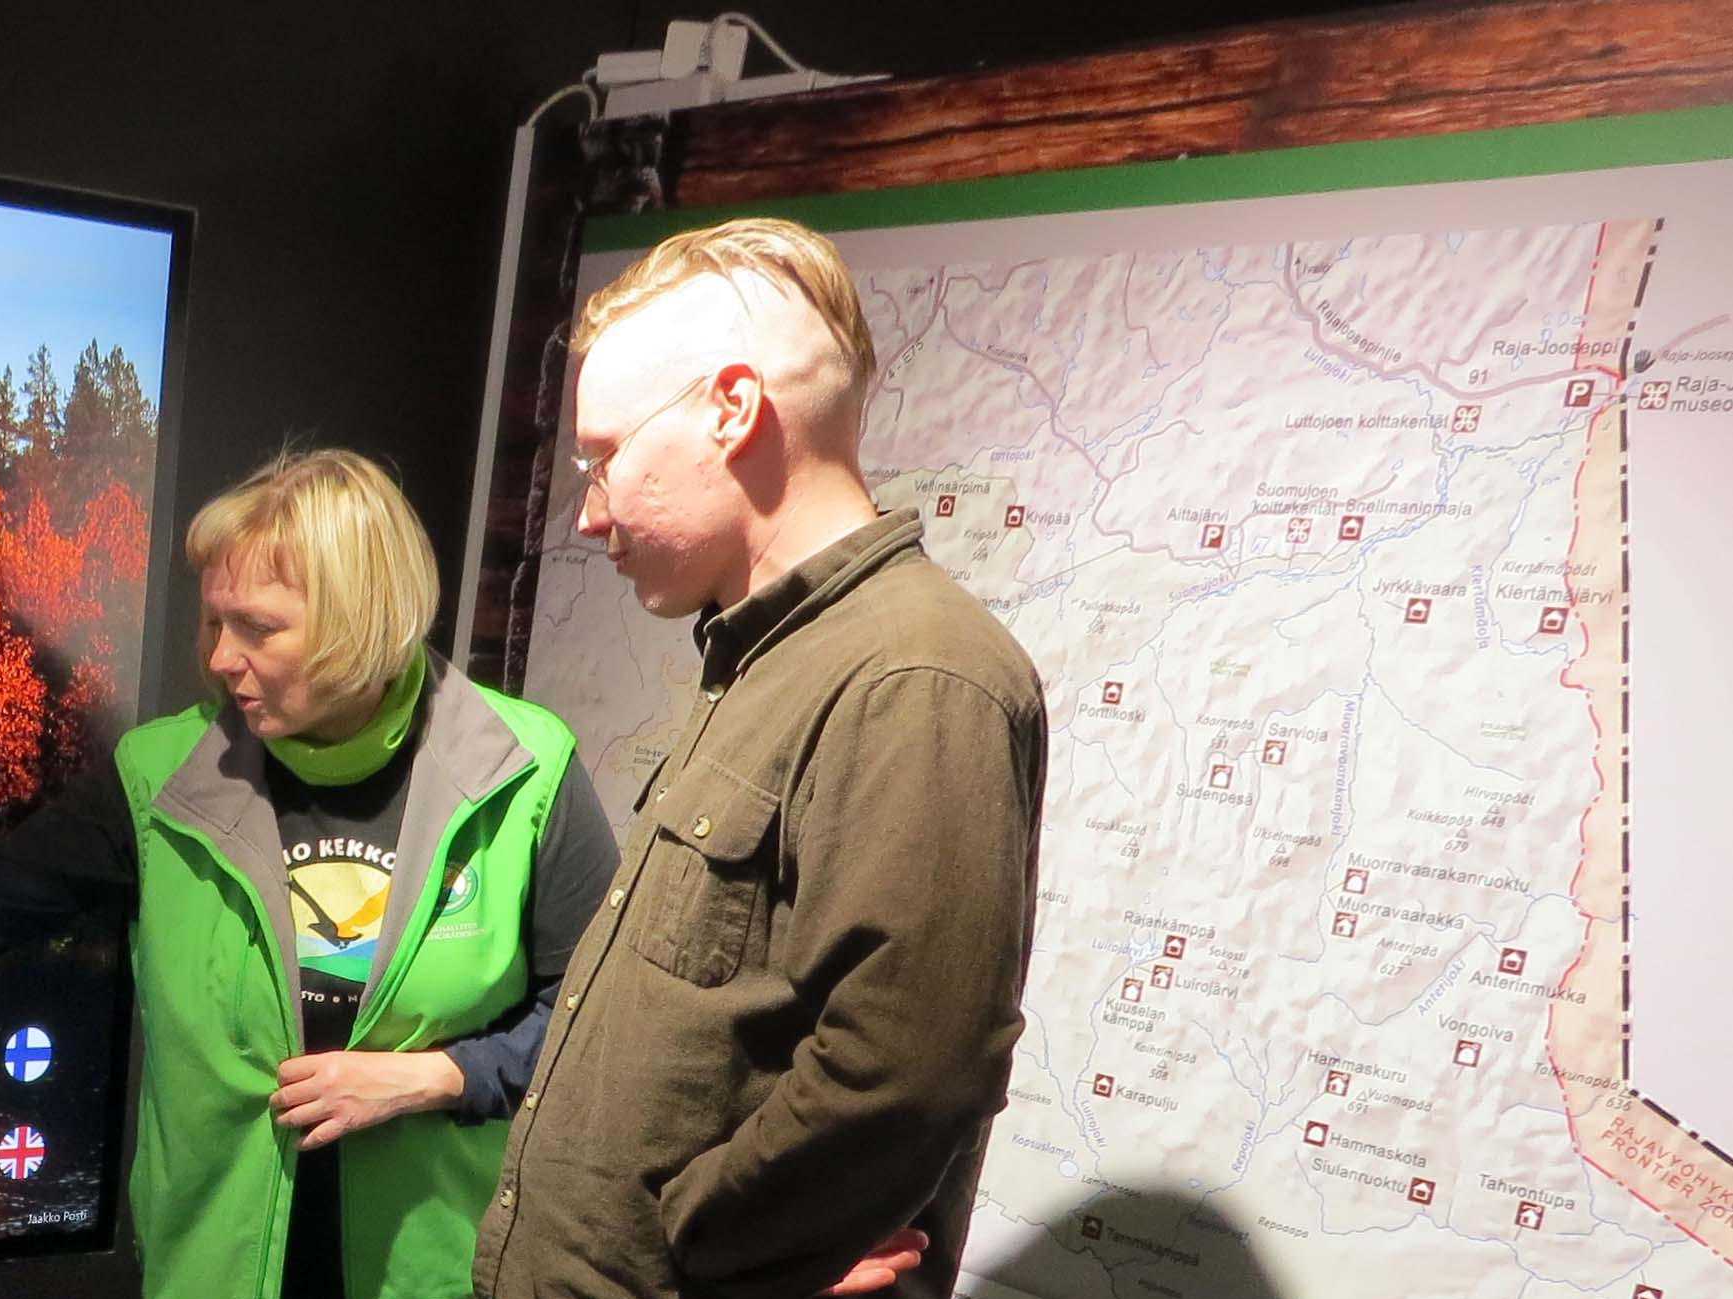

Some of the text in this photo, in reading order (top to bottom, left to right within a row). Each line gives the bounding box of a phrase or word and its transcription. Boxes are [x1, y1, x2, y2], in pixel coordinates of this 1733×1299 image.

[1302, 262, 1332, 276] Ivalo
[1317, 299, 1403, 364] Rajajoosepintie
[1491, 338, 1620, 358] Raja-Jooseppi
[1468, 369, 1490, 385] 91
[1284, 412, 1449, 430] Luttojoen kolttakentät
[1255, 482, 1339, 500] Suomujoen
[1026, 510, 1071, 526] Kivipää
[1167, 507, 1229, 523] Aittajärvi
[1251, 499, 1338, 516] kolttakentät
[1168, 574, 1229, 601] Suomujoki
[1372, 578, 1467, 598] Jyrkkävaara
[1495, 583, 1615, 605] Kiertämäjärvi
[1078, 703, 1147, 723] Porttikoski
[1268, 721, 1329, 744] Sarvioja
[1331, 699, 1357, 837] Muorravaarakanjoki
[1176, 783, 1254, 807] Sudenpesä
[1443, 840, 1470, 852] 679
[1347, 852, 1531, 894] Muorravaarakanruoktu
[1123, 909, 1217, 940] Rajankämppä
[1336, 895, 1465, 931] Muorravaarakka
[1208, 944, 1247, 963] Sokosti
[1228, 965, 1250, 980] 718
[1379, 962, 1404, 977] 627
[1174, 974, 1240, 1000] Luirojärvi
[1417, 958, 1467, 1017] Anterijoki
[1469, 970, 1587, 1005] Anterinmukka
[1105, 997, 1167, 1022] Kuuselan
[1102, 1013, 1155, 1034] kämppä
[1437, 1013, 1515, 1042] Vongoiva
[1307, 1047, 1408, 1084] Hammaskuru
[1116, 1082, 1179, 1112] Karapulju
[1080, 1099, 1107, 1148] Luirojoki
[1231, 1119, 1257, 1173] Repojoki
[1329, 1131, 1428, 1169] Hammaskota
[1601, 1128, 1695, 1198] FRONTIER
[1610, 1116, 1733, 1206] RAJAVYÖHYK
[1311, 1157, 1408, 1195] Siulanruoktu
[1479, 1173, 1577, 1211] Tahvontupa
[27, 1208, 88, 1225] Jaakko Posti
